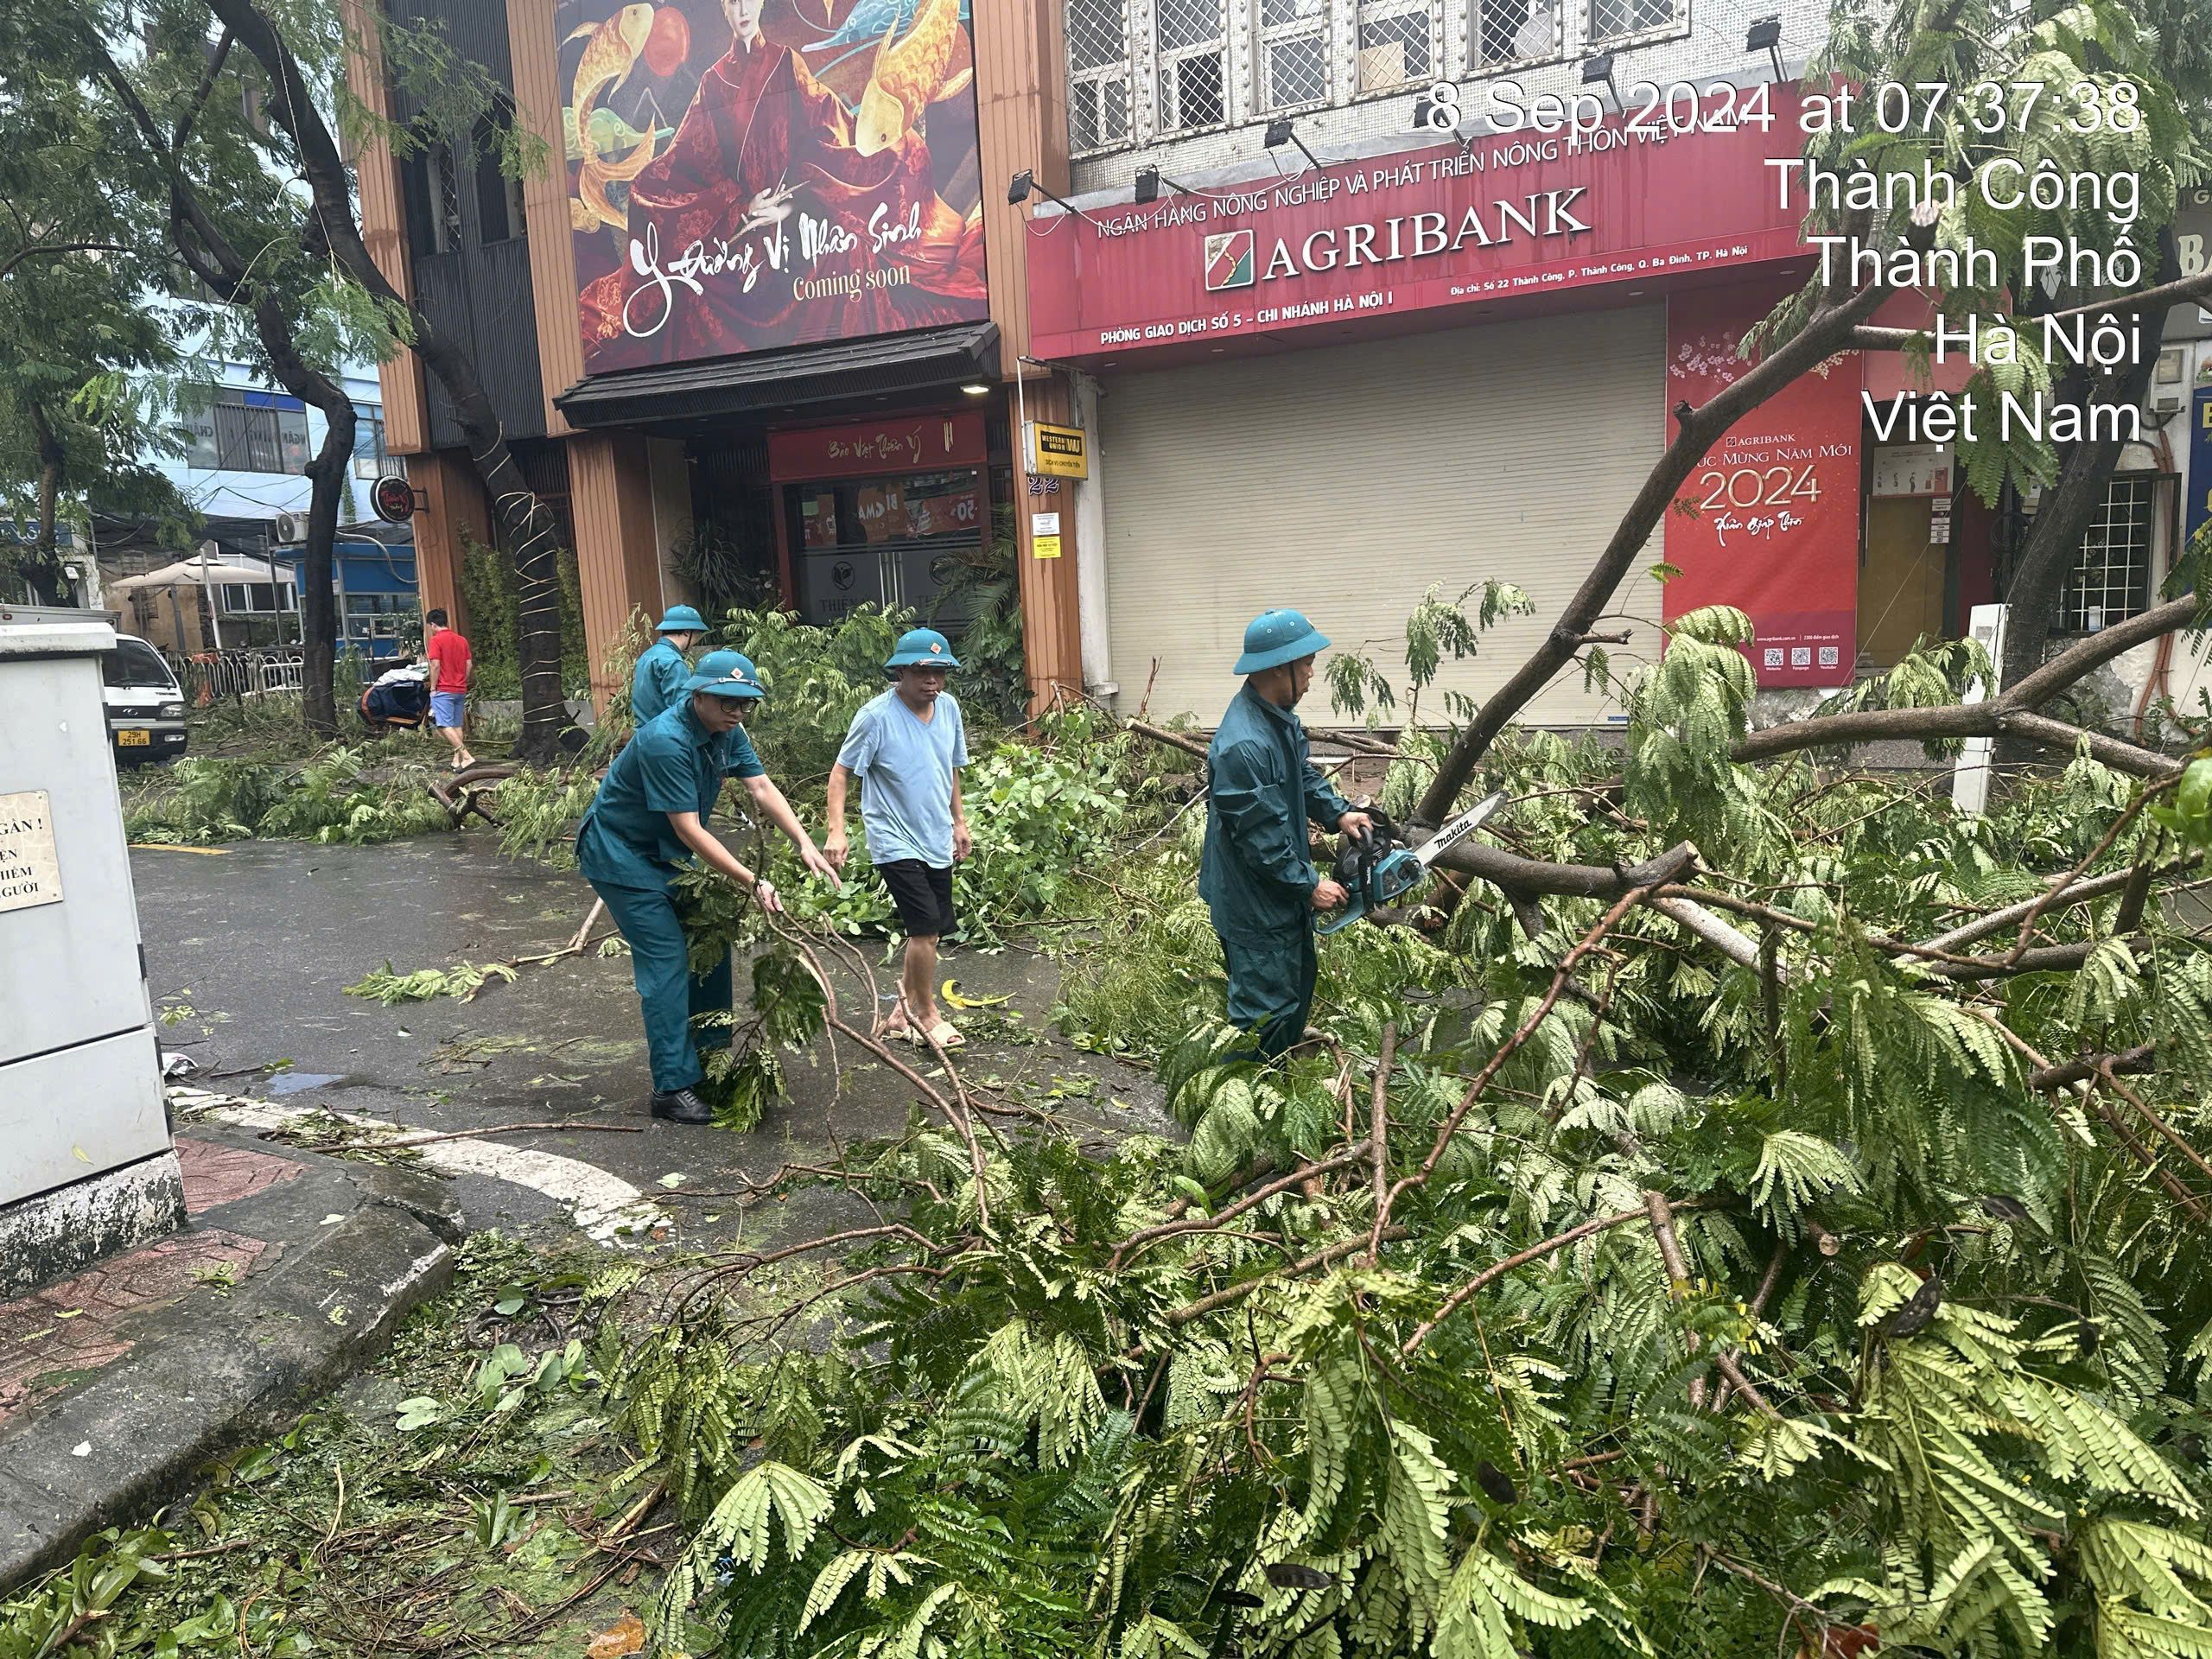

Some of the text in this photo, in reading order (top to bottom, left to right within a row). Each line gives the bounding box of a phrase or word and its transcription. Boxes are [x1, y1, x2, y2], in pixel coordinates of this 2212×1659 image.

[1097, 213, 1147, 238] NGÂN
[1154, 202, 1206, 230] HÀNG
[1213, 192, 1268, 219] NÔNG
[1274, 177, 1340, 208] NGHIỆP
[1346, 169, 1369, 194] VÀ
[1372, 159, 1425, 191] PHÁT
[1428, 145, 1484, 180] TRIỂN
[1493, 138, 1558, 169] NÔNG
[1561, 126, 1628, 157] THÔN
[764, 215, 790, 274] Vị
[798, 212, 858, 274] Nhân
[868, 200, 921, 255] Sinh
[1262, 186, 1592, 281] AGRIBANK
[1450, 285, 1465, 296] Địa
[1483, 279, 1495, 290] Số
[1497, 278, 1510, 289] 22
[1512, 273, 1539, 287] Thành
[1568, 269, 1578, 278] P.
[1580, 264, 1607, 278] Thành
[1638, 259, 1649, 269] Q.
[1652, 257, 1665, 267] Ba
[1696, 251, 1713, 261] TP.
[1715, 248, 1728, 258] Hà
[1731, 245, 1748, 257] Nội
[2177, 233, 2212, 277] B
[792, 263, 912, 303] Coming soon
[1100, 323, 1141, 346] PHÒNG
[1145, 322, 1174, 340] GIAO
[1178, 319, 1207, 337] DỊCH
[1211, 310, 1230, 331] SỐ
[1232, 316, 1242, 327] 5
[1257, 309, 1279, 324] CHI
[1281, 299, 1329, 321] NHÁNH
[1333, 293, 1355, 312] HÀ
[1358, 289, 1384, 310] NỘI
[1041, 435, 1066, 444] WESTERN
[1049, 442, 1066, 451] UNION
[1722, 450, 1770, 466] MỪNG
[1776, 447, 1813, 461] NĂM
[1819, 442, 1853, 458] MỚI
[1738, 434, 1797, 447] AGRIBANK
[1027, 475, 1059, 497] 22
[1700, 465, 1822, 511] 2024
[0, 880, 40, 898] GƯỜI
